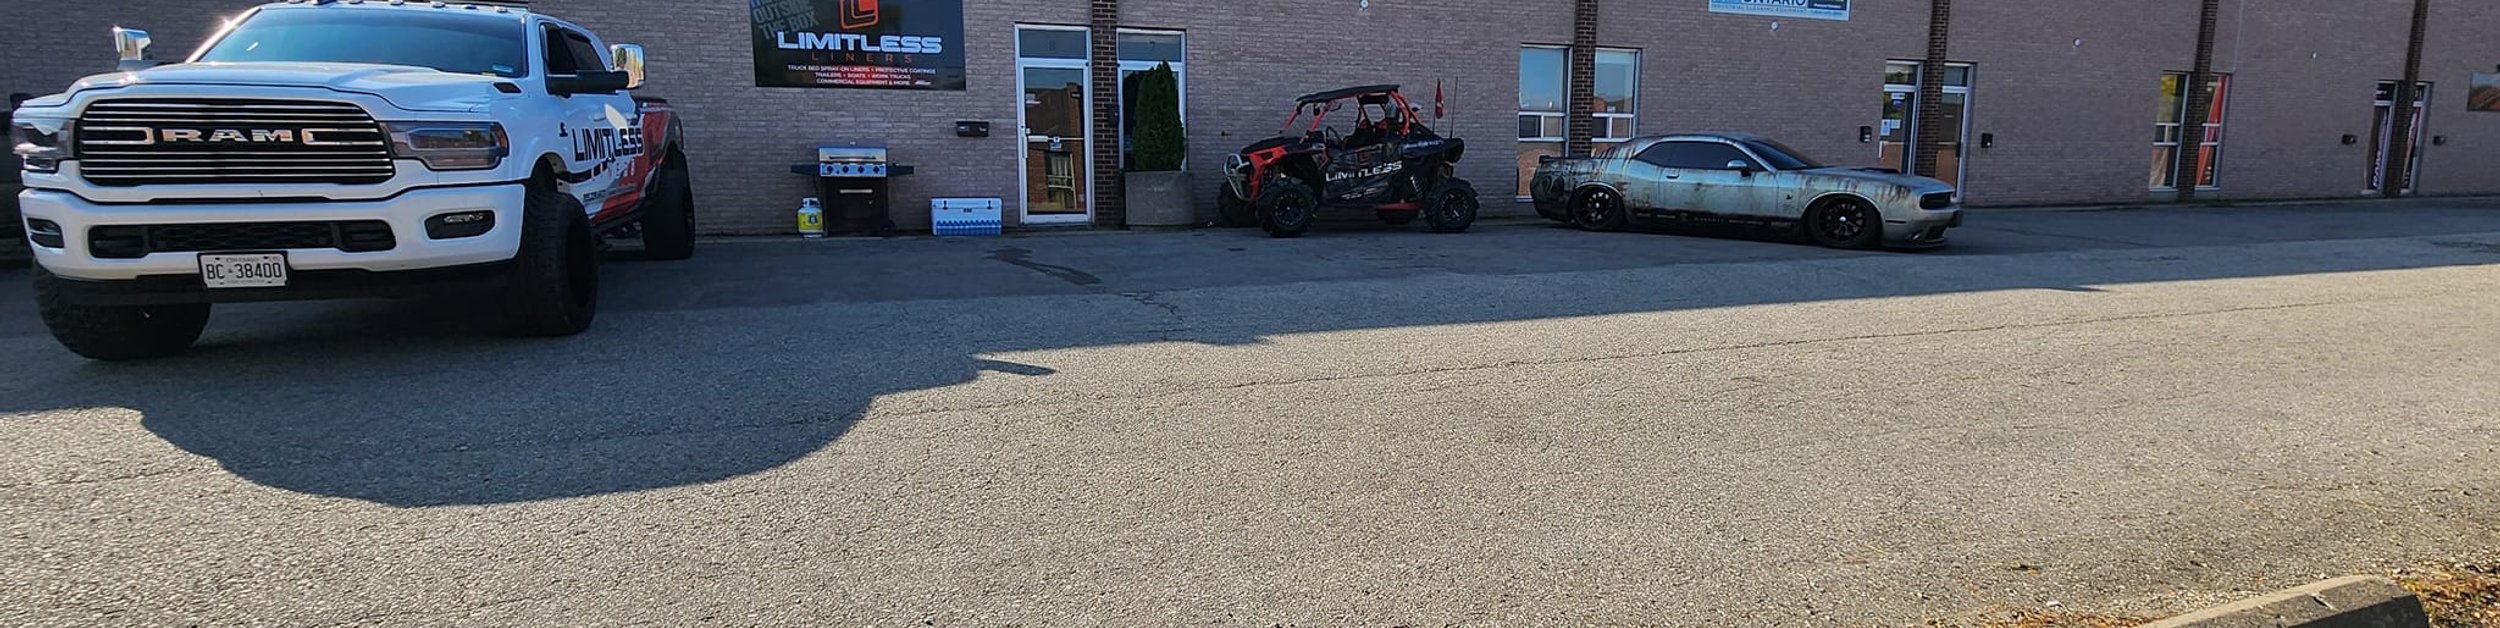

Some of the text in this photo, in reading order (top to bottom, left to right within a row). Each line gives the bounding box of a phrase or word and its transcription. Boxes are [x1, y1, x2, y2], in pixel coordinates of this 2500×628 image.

[787, 10, 819, 33] BOX
[777, 31, 942, 54] LIMITLESS
[811, 52, 913, 63] LINERS
[161, 128, 294, 142] RAM
[572, 127, 644, 162] LIMITLESS
[1325, 160, 1402, 182] LIMITLESS
[206, 264, 225, 280] BC
